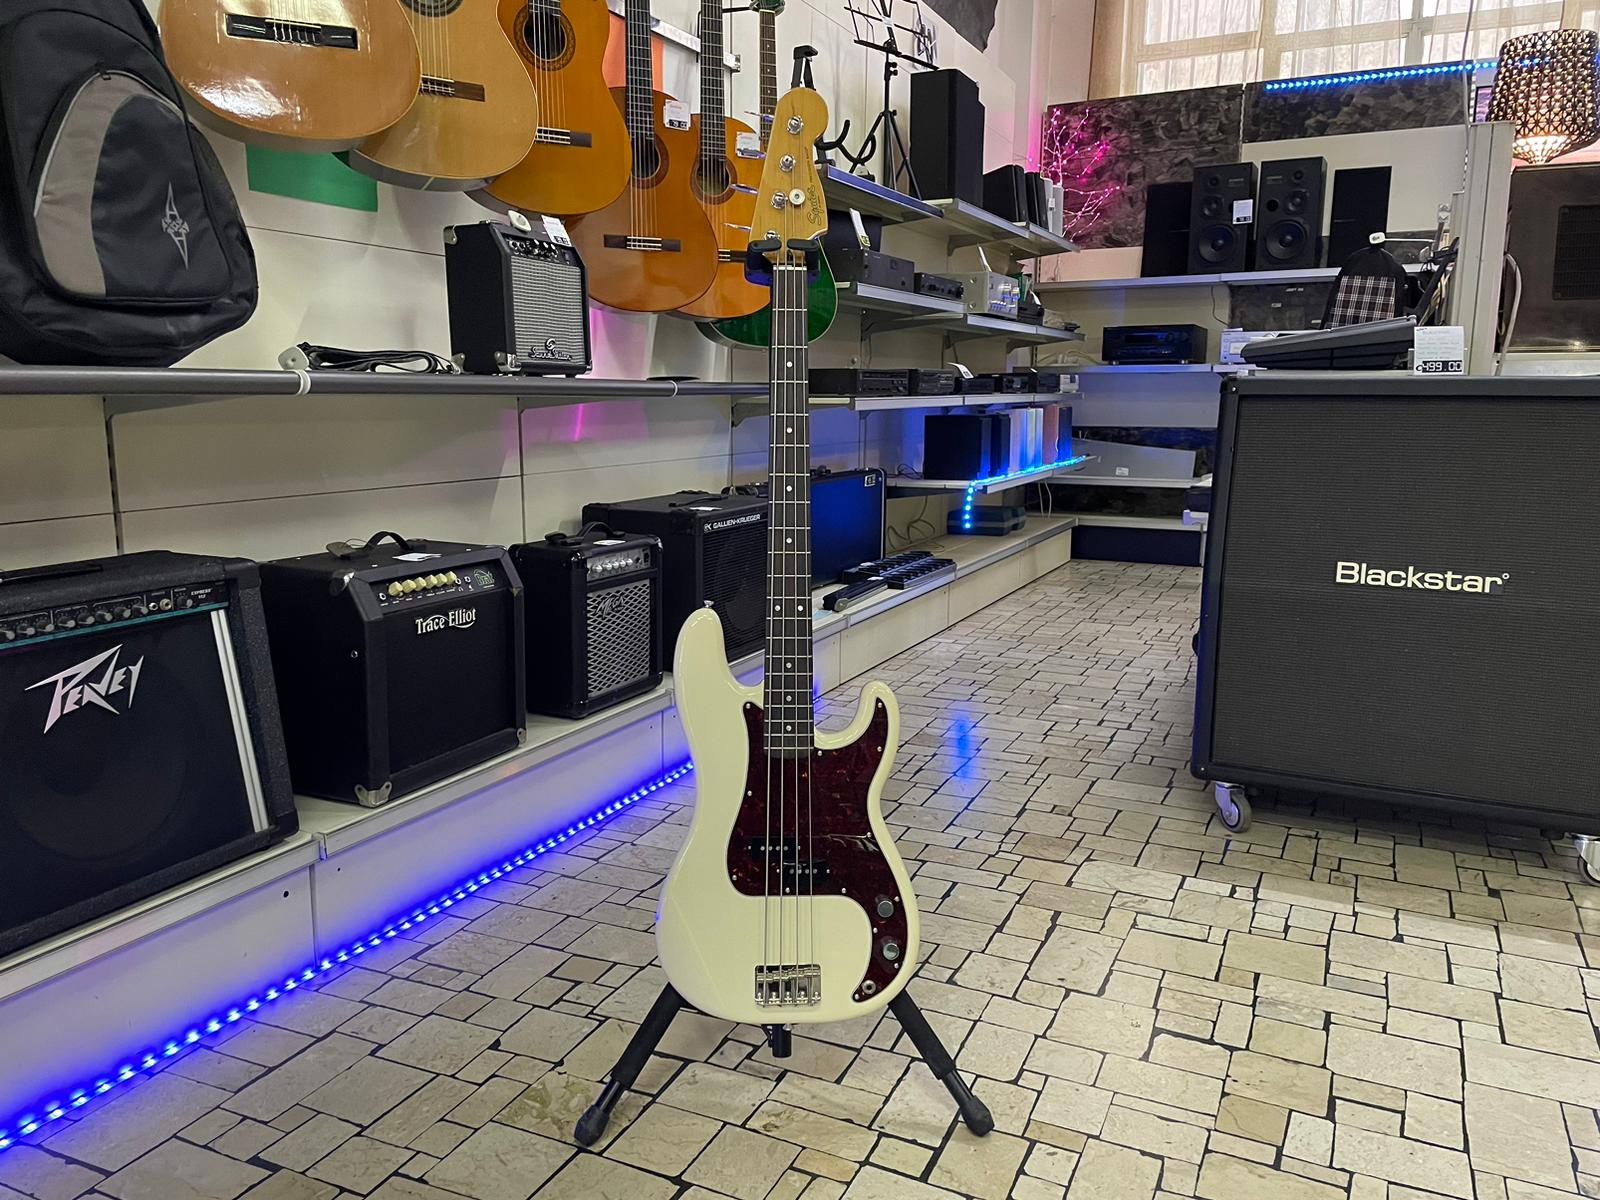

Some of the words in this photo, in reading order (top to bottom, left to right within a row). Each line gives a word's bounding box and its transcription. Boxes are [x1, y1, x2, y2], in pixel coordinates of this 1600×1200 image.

[712, 514, 761, 529] GALLIEN-KRUEGER
[1335, 561, 1503, 593] Blackstar
[415, 615, 446, 635] Trace
[447, 608, 477, 628] Elliot
